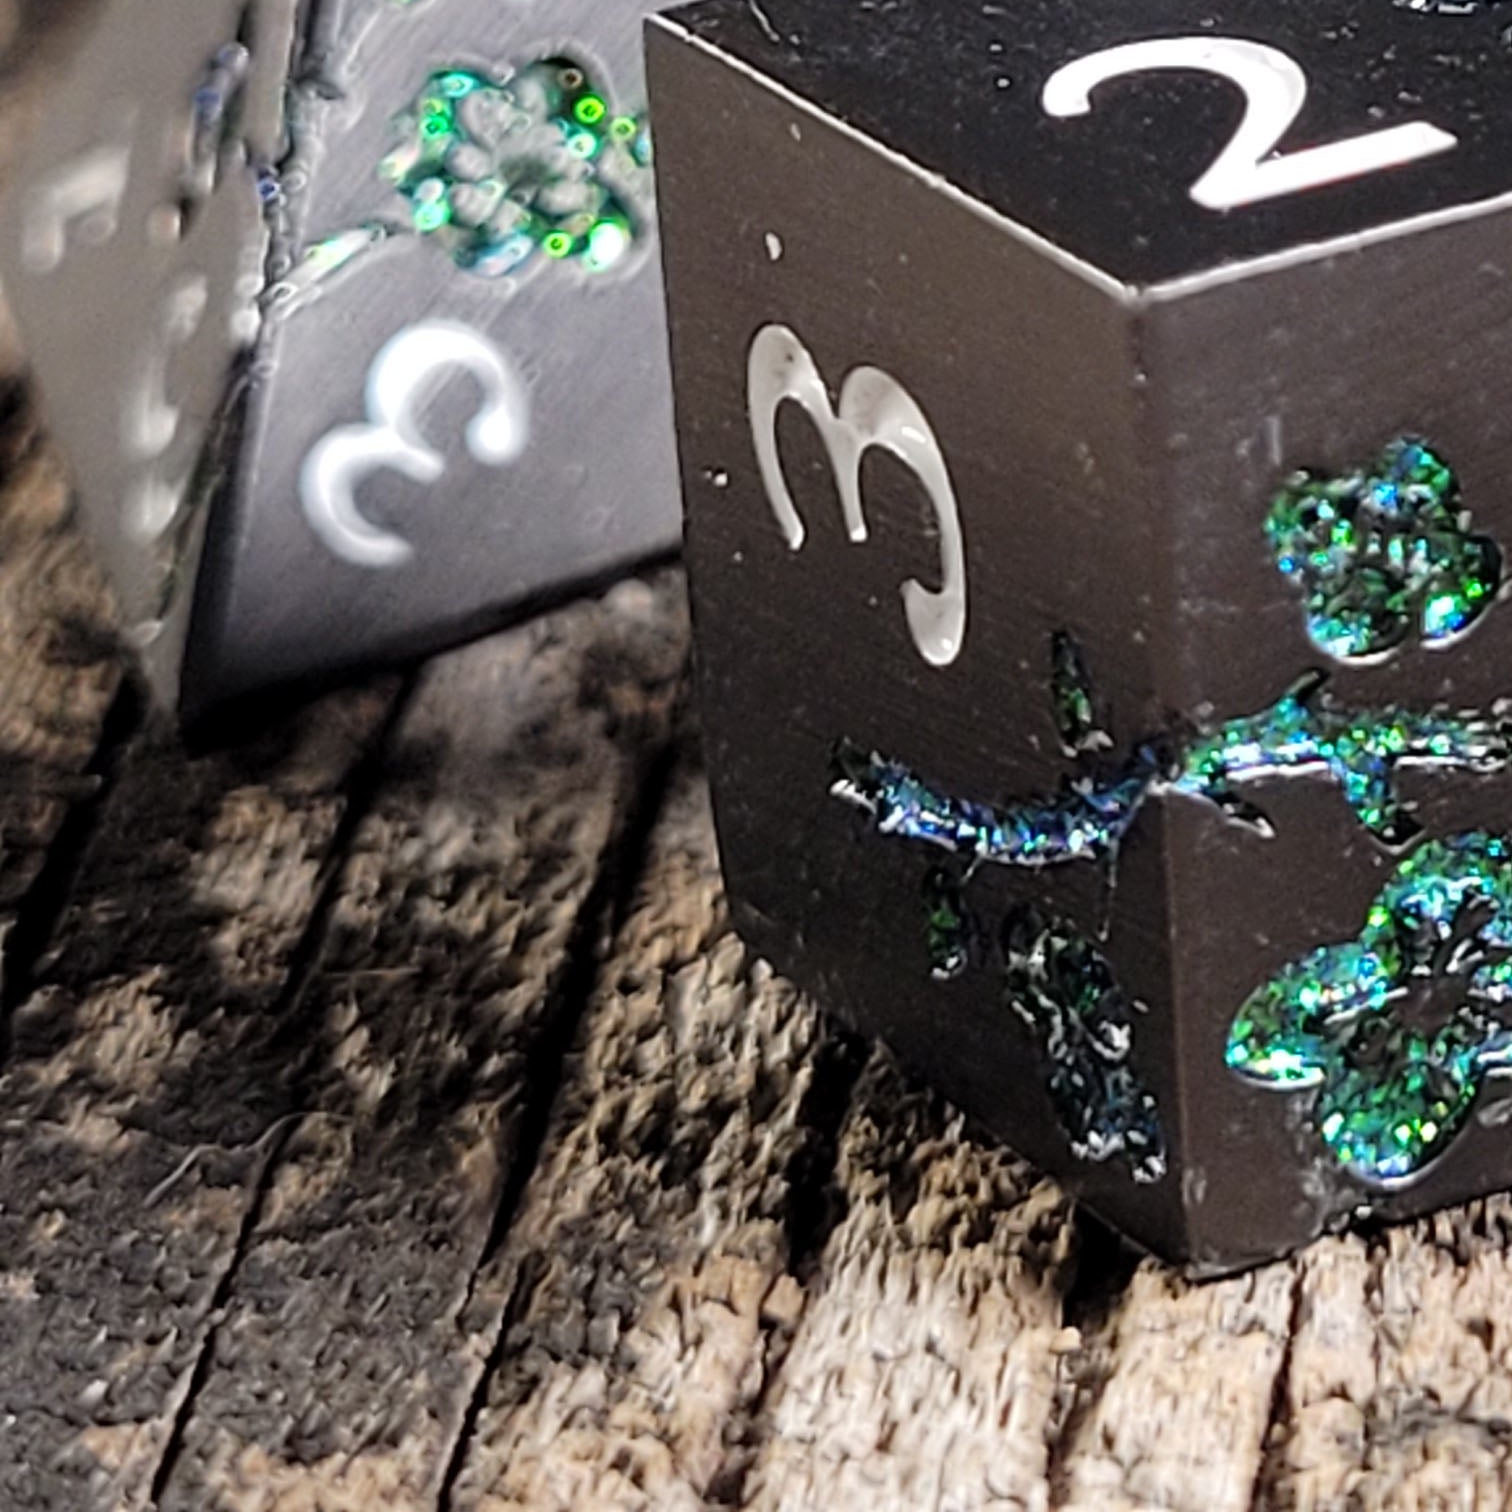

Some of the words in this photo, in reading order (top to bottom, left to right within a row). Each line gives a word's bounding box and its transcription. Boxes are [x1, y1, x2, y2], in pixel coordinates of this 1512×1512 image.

[1043, 34, 1458, 208] 2
[300, 319, 530, 566] 3
[747, 324, 966, 666] 3
